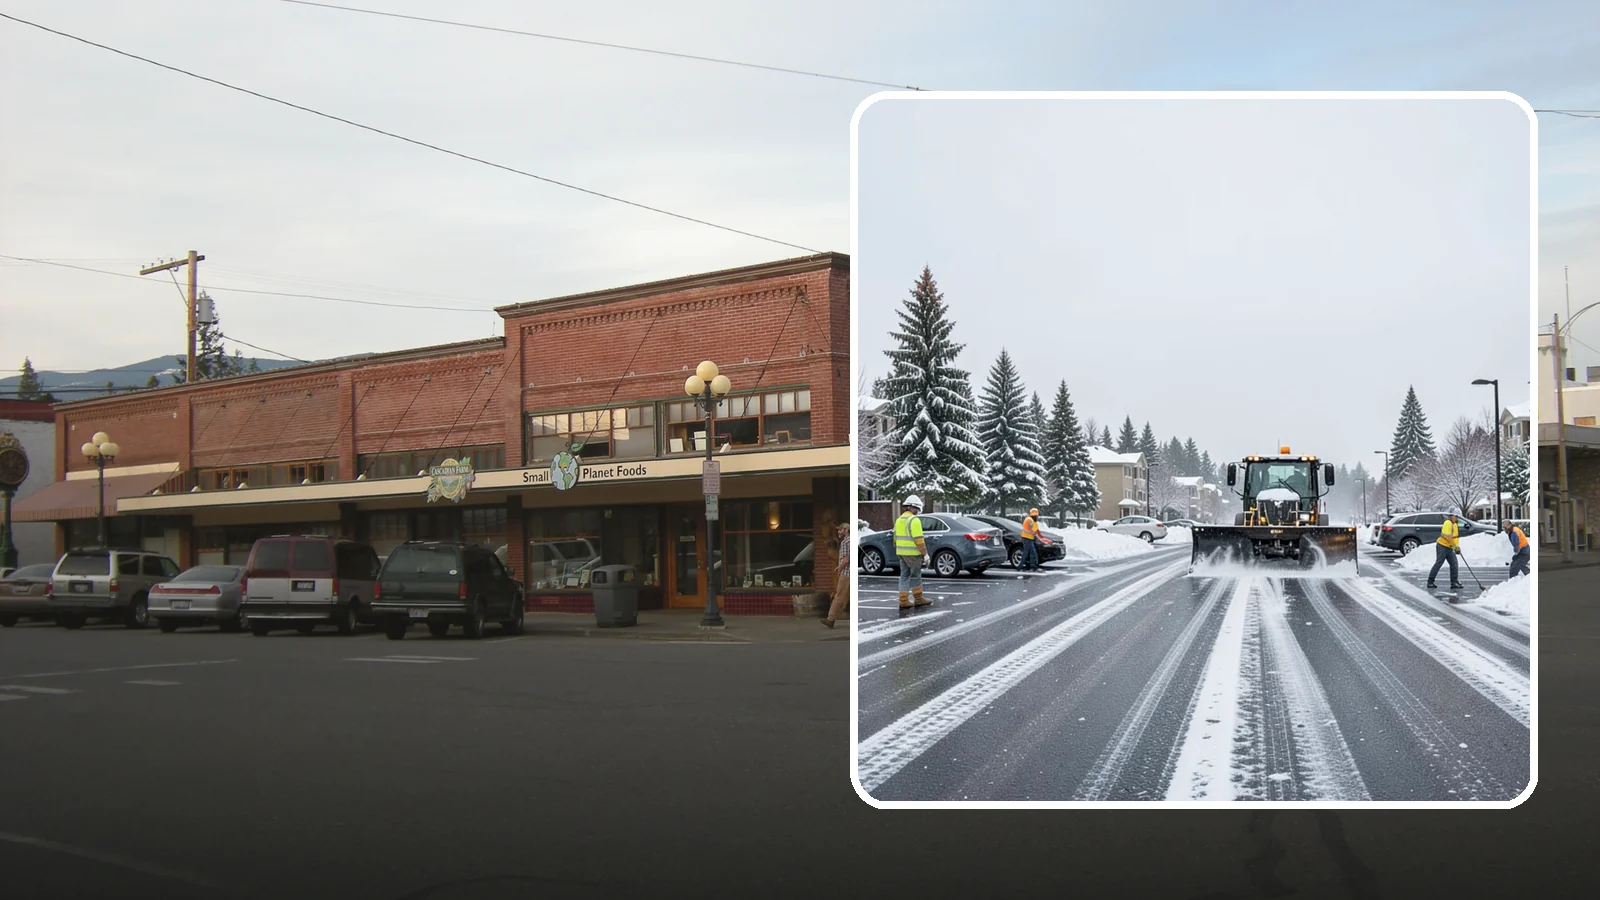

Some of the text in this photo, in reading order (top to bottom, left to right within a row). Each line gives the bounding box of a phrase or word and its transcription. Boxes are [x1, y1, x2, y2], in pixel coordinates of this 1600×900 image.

[523, 464, 647, 483] Small Planet Foods
